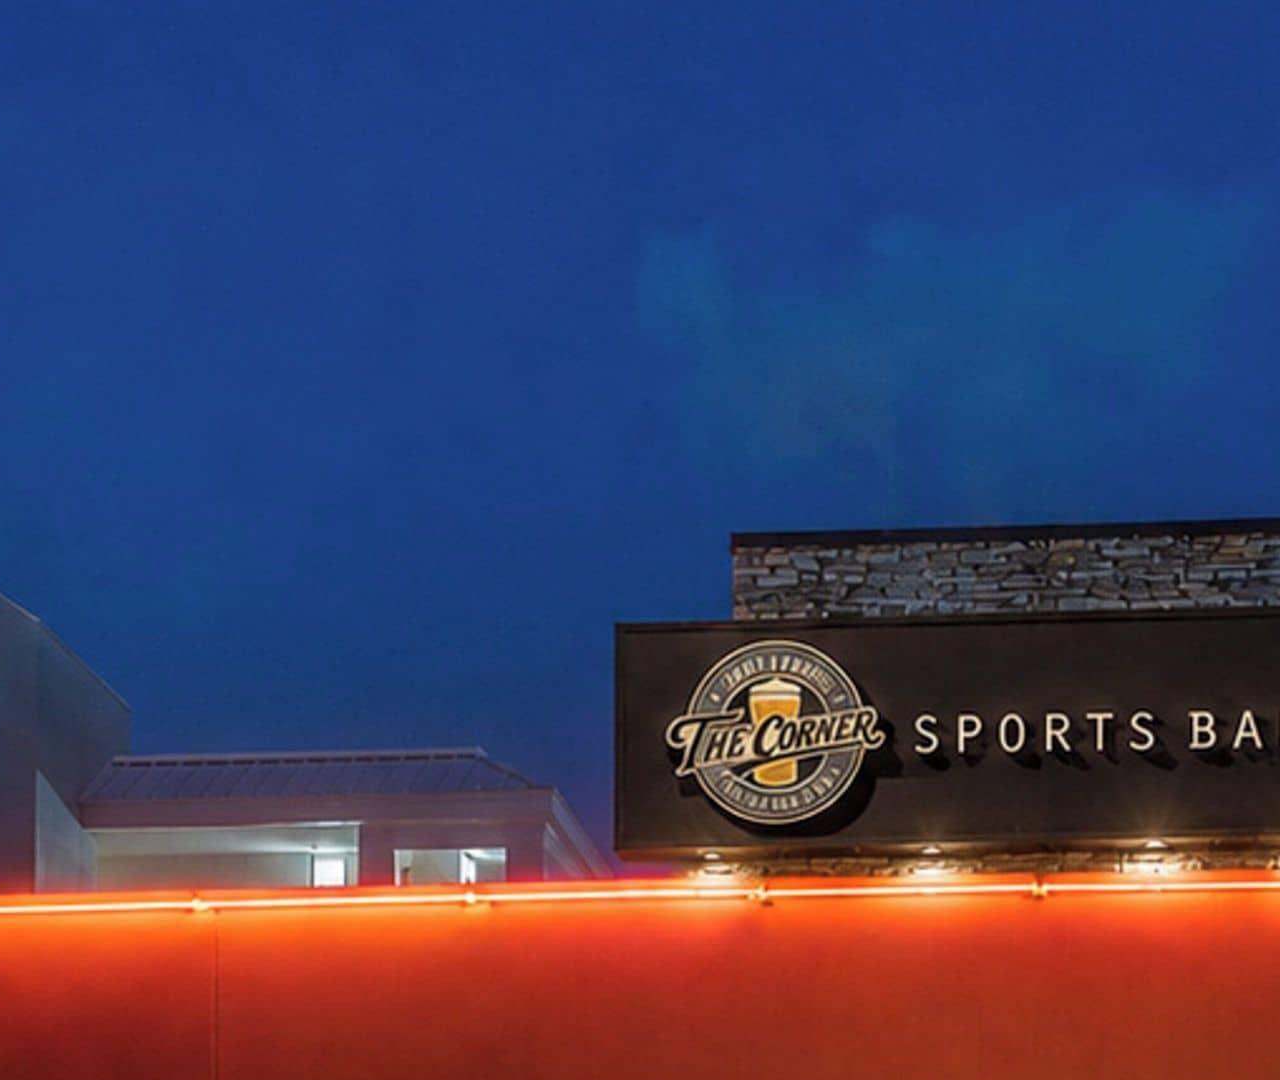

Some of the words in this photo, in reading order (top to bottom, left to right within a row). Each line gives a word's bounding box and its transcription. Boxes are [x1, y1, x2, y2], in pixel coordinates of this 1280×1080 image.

[670, 709, 752, 773] THE
[752, 706, 884, 758] CORNER
[915, 711, 1156, 753] SPORTS
